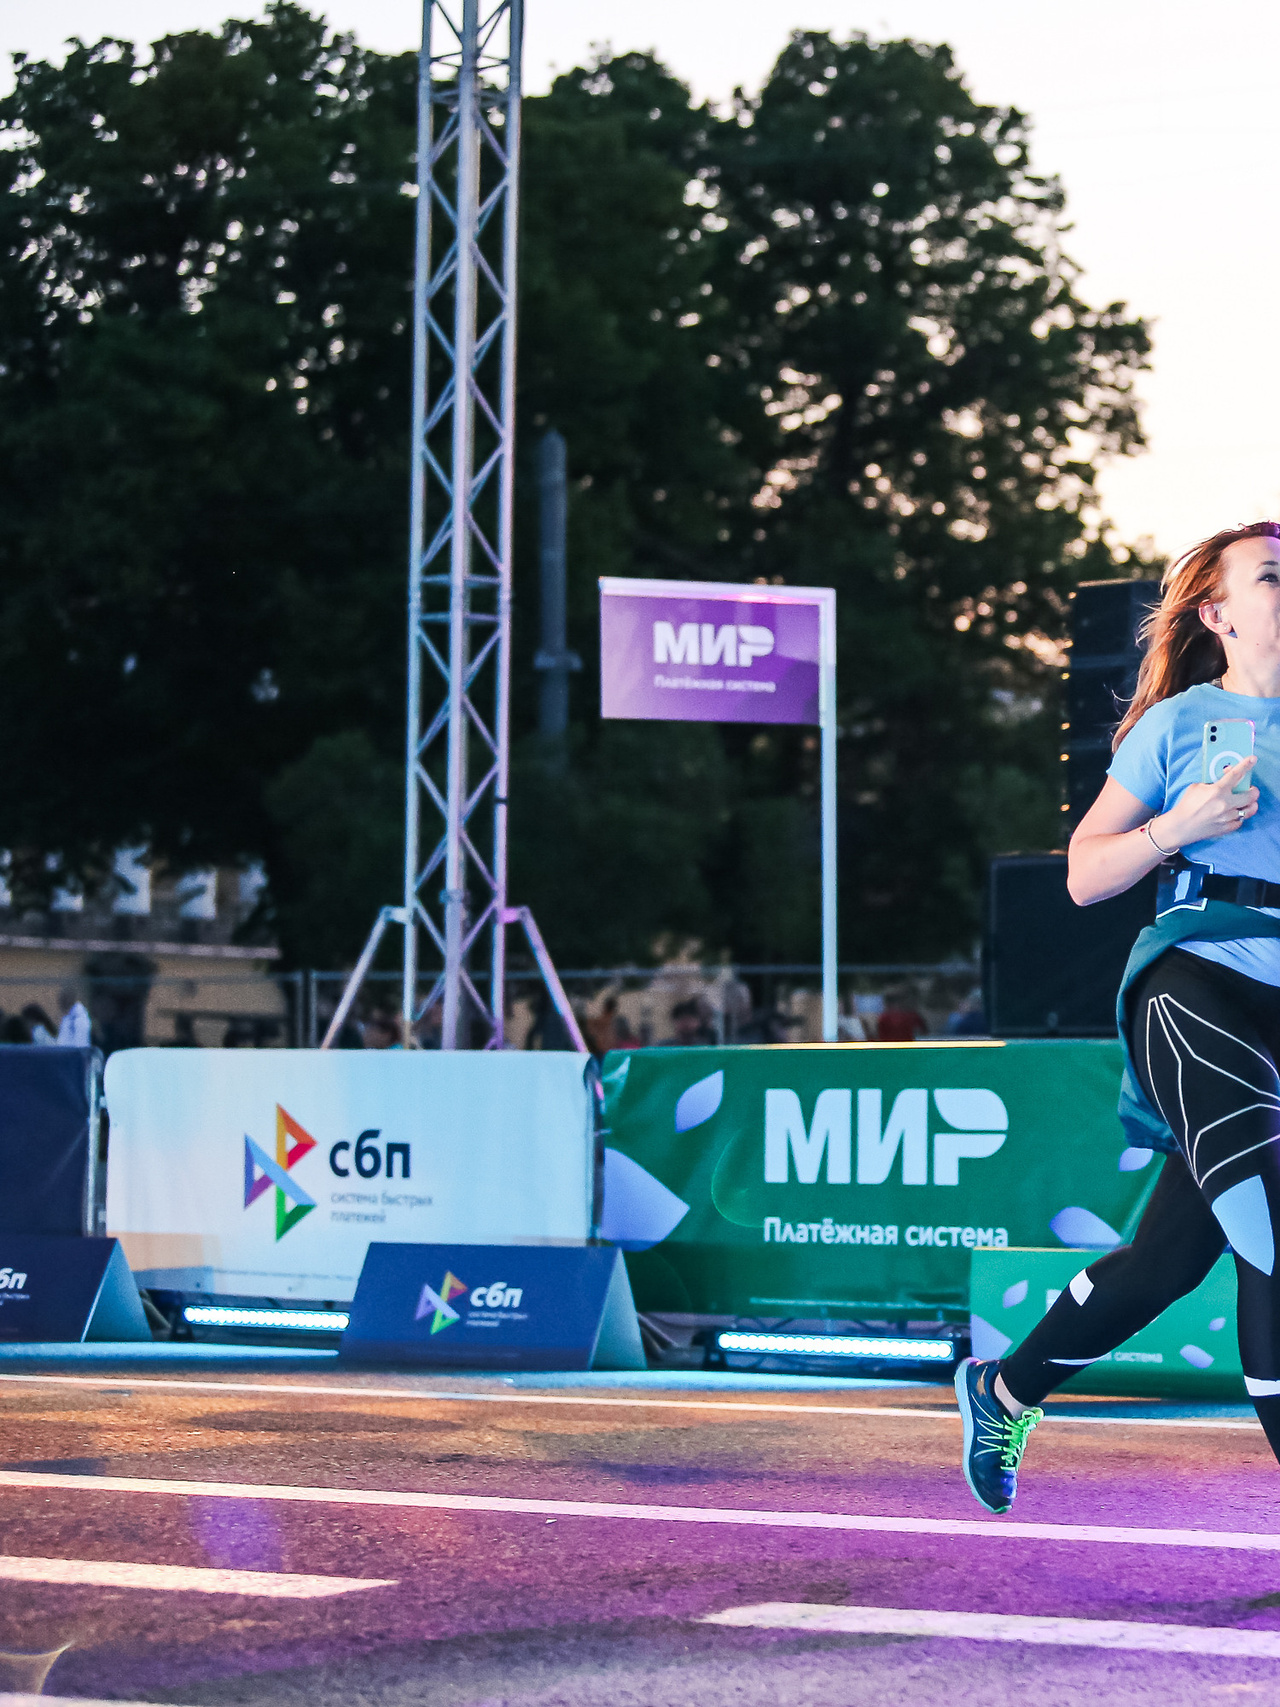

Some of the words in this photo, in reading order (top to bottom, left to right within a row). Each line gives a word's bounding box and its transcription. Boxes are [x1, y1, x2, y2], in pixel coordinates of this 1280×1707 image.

[653, 621, 775, 667] МИР
[329, 1128, 411, 1179] сбп
[764, 1088, 1009, 1186] МИР
[764, 1217, 899, 1245] Платёжная
[904, 1225, 1009, 1248] система
[469, 1281, 524, 1309] сбп
